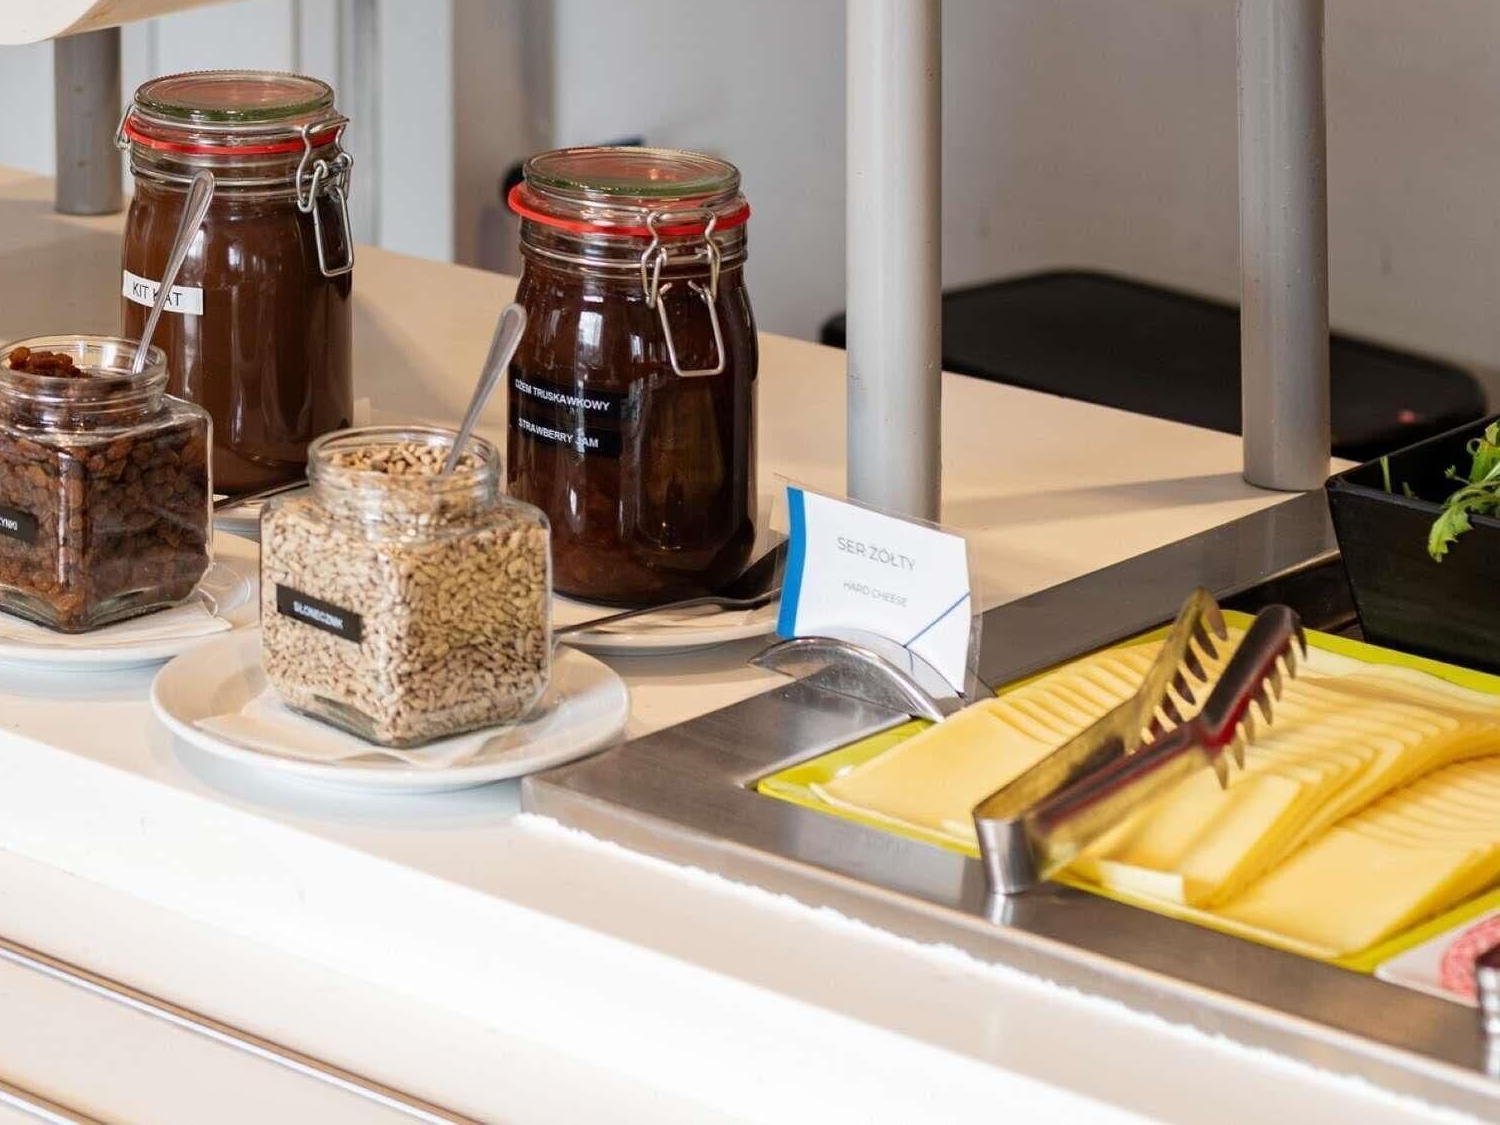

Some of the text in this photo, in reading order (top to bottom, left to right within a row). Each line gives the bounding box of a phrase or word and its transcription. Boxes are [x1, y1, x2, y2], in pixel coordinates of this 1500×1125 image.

[132, 282, 182, 307] KIT KAT
[533, 386, 610, 411] TRUSKAWKOWY
[518, 417, 599, 448] STRAWBERRY JAM
[837, 536, 867, 557] SER
